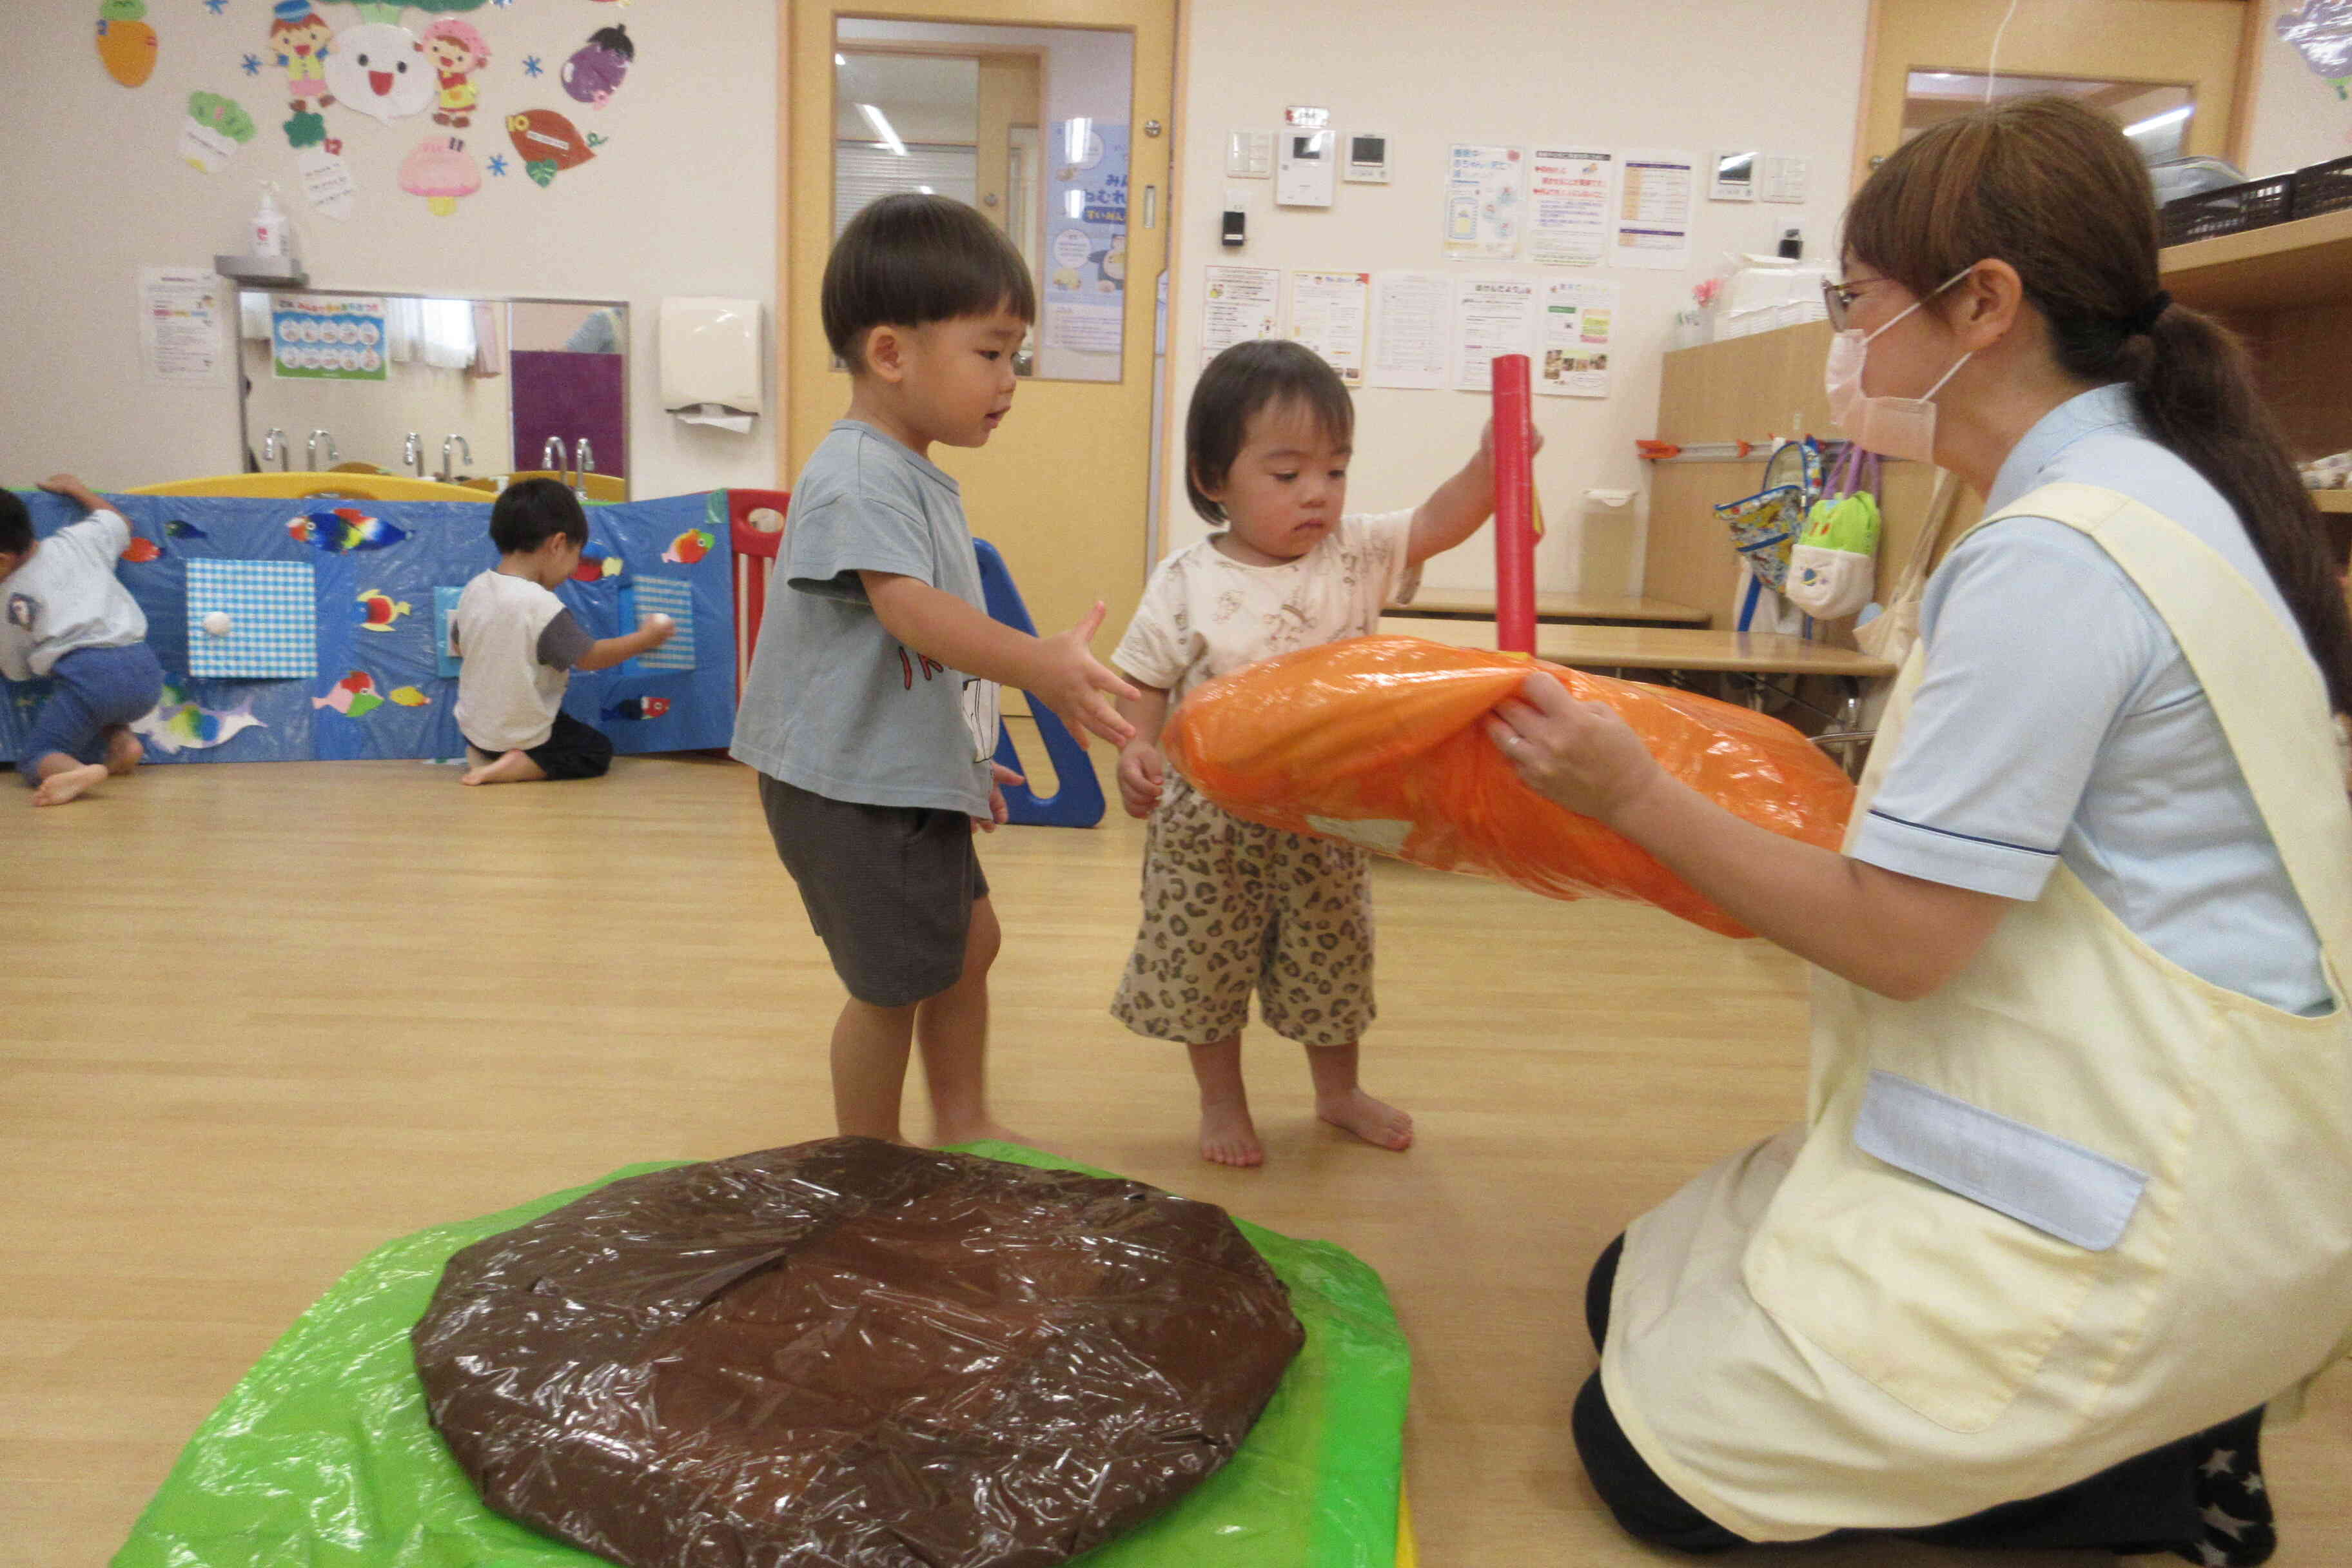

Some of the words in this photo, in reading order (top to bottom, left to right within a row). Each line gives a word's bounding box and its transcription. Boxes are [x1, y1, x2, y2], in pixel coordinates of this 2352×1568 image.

[507, 114, 529, 132] 10
[324, 138, 343, 156] 12
[449, 135, 465, 152] 11
